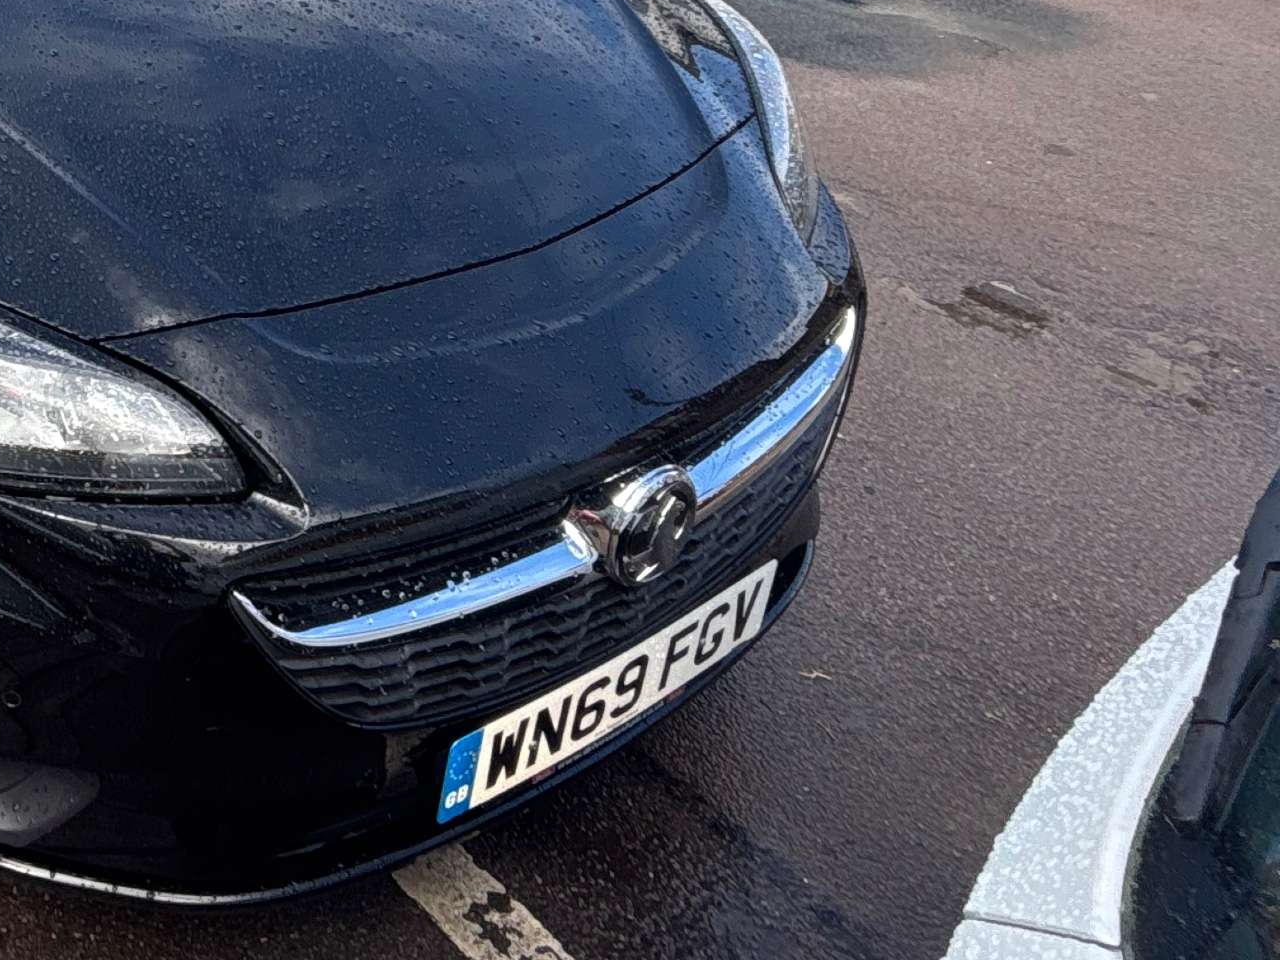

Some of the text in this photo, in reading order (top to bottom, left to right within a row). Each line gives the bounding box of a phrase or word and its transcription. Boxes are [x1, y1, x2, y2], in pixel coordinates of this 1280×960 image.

[486, 655, 649, 789] WN69
[658, 580, 762, 691] FGV
[445, 784, 469, 809] GB
